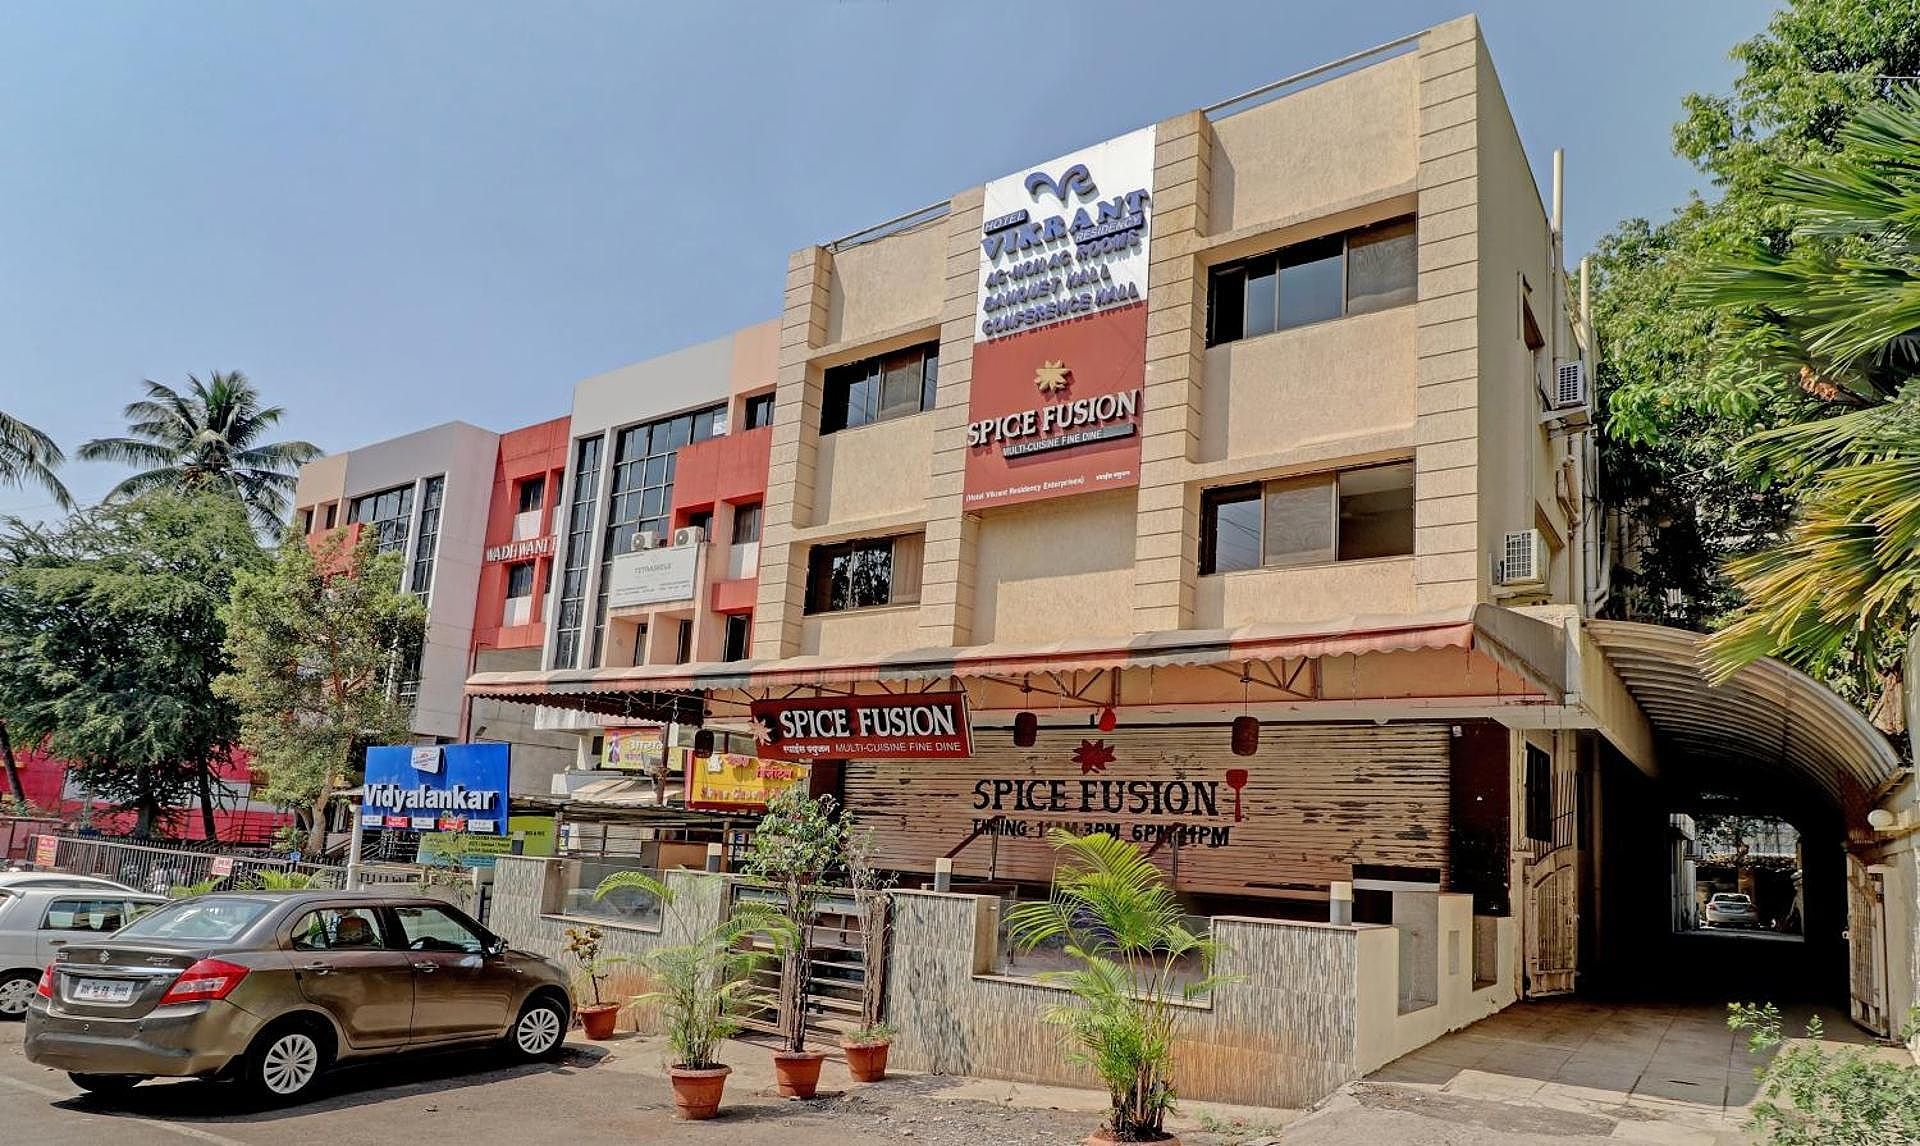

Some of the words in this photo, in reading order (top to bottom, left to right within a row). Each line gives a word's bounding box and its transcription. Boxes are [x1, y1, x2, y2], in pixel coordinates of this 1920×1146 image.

[981, 189, 1150, 260] VIKRANT
[984, 210, 1028, 232] HOTEL
[1075, 213, 1143, 242] RESIDENCY
[1076, 230, 1141, 263] ROOMS
[983, 277, 1062, 313] BANQUET
[1066, 264, 1112, 290] HALL
[982, 293, 1093, 336] CONFERENCE
[1095, 281, 1140, 307] HALL
[968, 410, 1038, 447] SPICE
[1042, 389, 1141, 433] FUSION
[1002, 437, 1060, 457] MULTI-CUISINE
[1061, 433, 1080, 446] FINE
[1082, 429, 1102, 442] DINE
[1009, 483, 1042, 496] Residency
[779, 708, 850, 739] SPICE
[856, 704, 957, 738] FUSION
[835, 743, 907, 753] MULTI-CUISINE
[908, 742, 933, 752] FINE
[935, 741, 962, 751] DINE
[363, 784, 495, 813] Vidyalankar
[972, 779, 1067, 811] SPICE
[1079, 780, 1220, 817] FUSION
